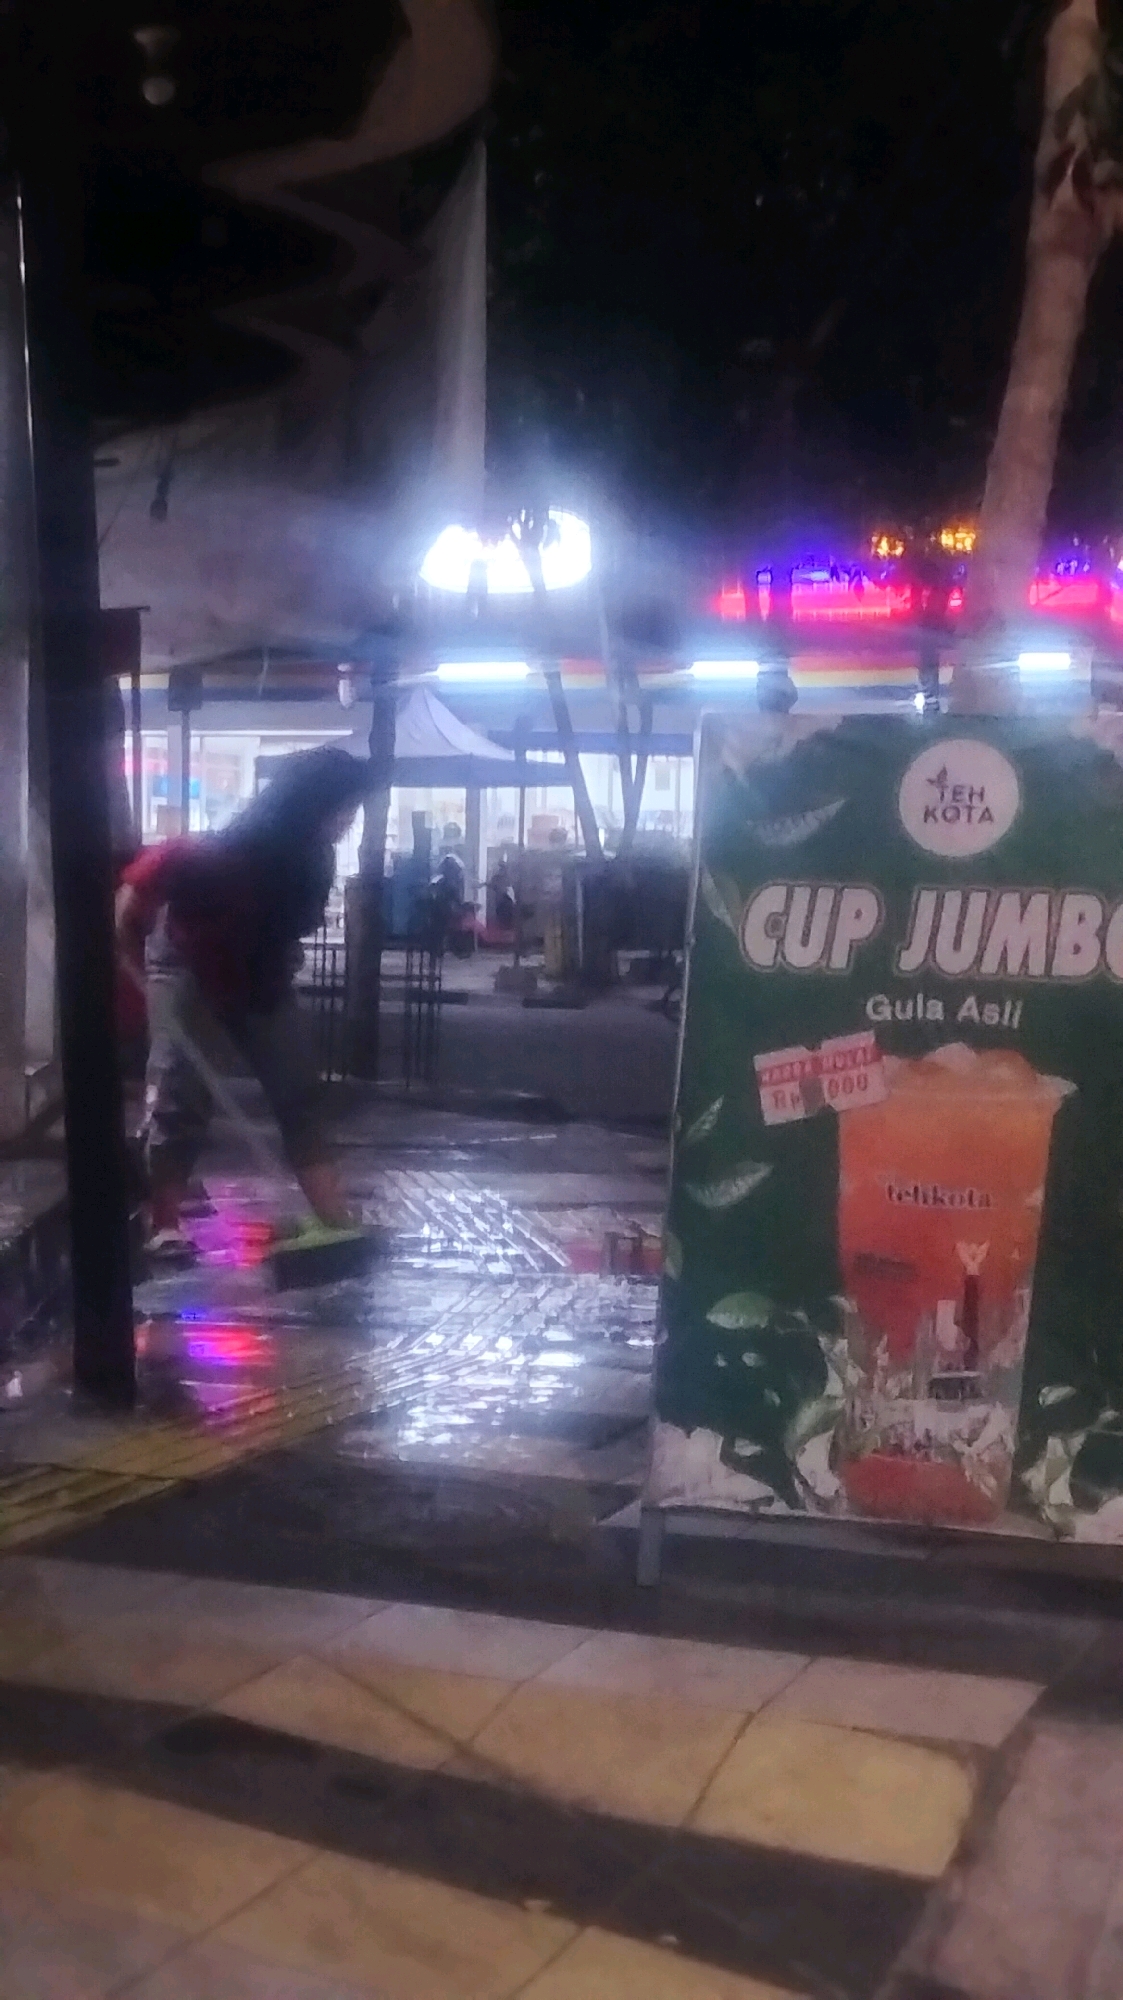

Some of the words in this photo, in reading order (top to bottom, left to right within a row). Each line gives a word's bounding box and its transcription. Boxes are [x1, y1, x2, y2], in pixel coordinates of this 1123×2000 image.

[939, 784, 985, 802] TEH
[923, 805, 994, 823] KOTA
[742, 883, 881, 973] CUP
[866, 993, 944, 1021] Gula
